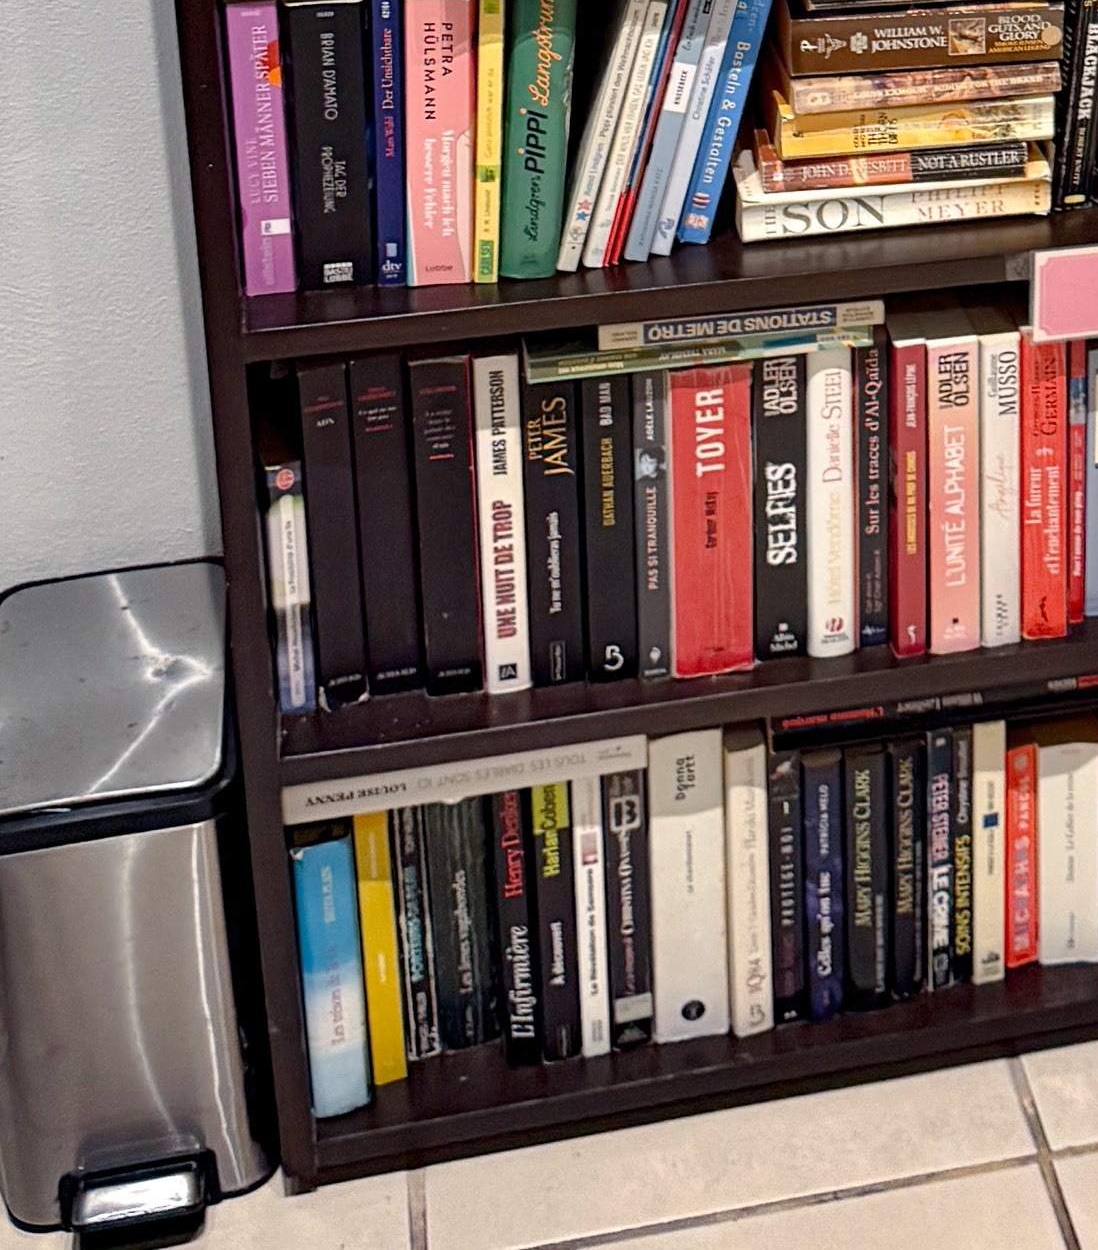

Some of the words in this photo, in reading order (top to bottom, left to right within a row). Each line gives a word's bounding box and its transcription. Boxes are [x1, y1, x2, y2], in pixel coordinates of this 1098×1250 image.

[249, 25, 270, 81] SPÄTER
[320, 32, 334, 71] BRIAN
[381, 27, 394, 84] Unsichtbare
[441, 22, 453, 77] PETRA
[871, 36, 948, 51] JOHNSTONE
[873, 27, 924, 39] WILLIAM
[927, 25, 944, 37] W.
[422, 22, 437, 121] HÜLSMANN
[724, 40, 752, 97] Basteln
[254, 82, 275, 147] MÄNNER
[322, 72, 339, 122] D'AMATO
[382, 86, 394, 110] Der
[524, 107, 547, 174] PIPPI
[703, 115, 733, 184] Gestalten
[259, 148, 280, 203] SIEBEN
[782, 197, 885, 235] SON
[916, 200, 1006, 221] MEYER
[647, 319, 714, 341] METRO
[716, 318, 741, 335] DE
[743, 310, 834, 333] STATIONS
[490, 370, 506, 435] PATTERSON
[998, 350, 1018, 417] MUSSO
[528, 419, 542, 460] PETER
[542, 396, 575, 476] JAMES
[695, 387, 725, 478] TOYER
[492, 439, 508, 475] JAMES
[944, 424, 965, 519] ALPHABET
[492, 500, 514, 538] TROP
[766, 463, 797, 566] SELFIES
[495, 539, 514, 560] DE
[942, 522, 967, 588] L'UNITÉ
[496, 562, 516, 604] NUIT
[497, 606, 518, 639] UNE
[305, 790, 355, 808] PENNY
[357, 784, 407, 800] LOUISE
[543, 786, 558, 832] Coben
[853, 768, 871, 820] CLARK
[543, 833, 561, 878] Harlan
[854, 821, 872, 883] HIGGINS
[854, 884, 872, 927] MARY
[506, 924, 536, 1039] L'Infirmière
